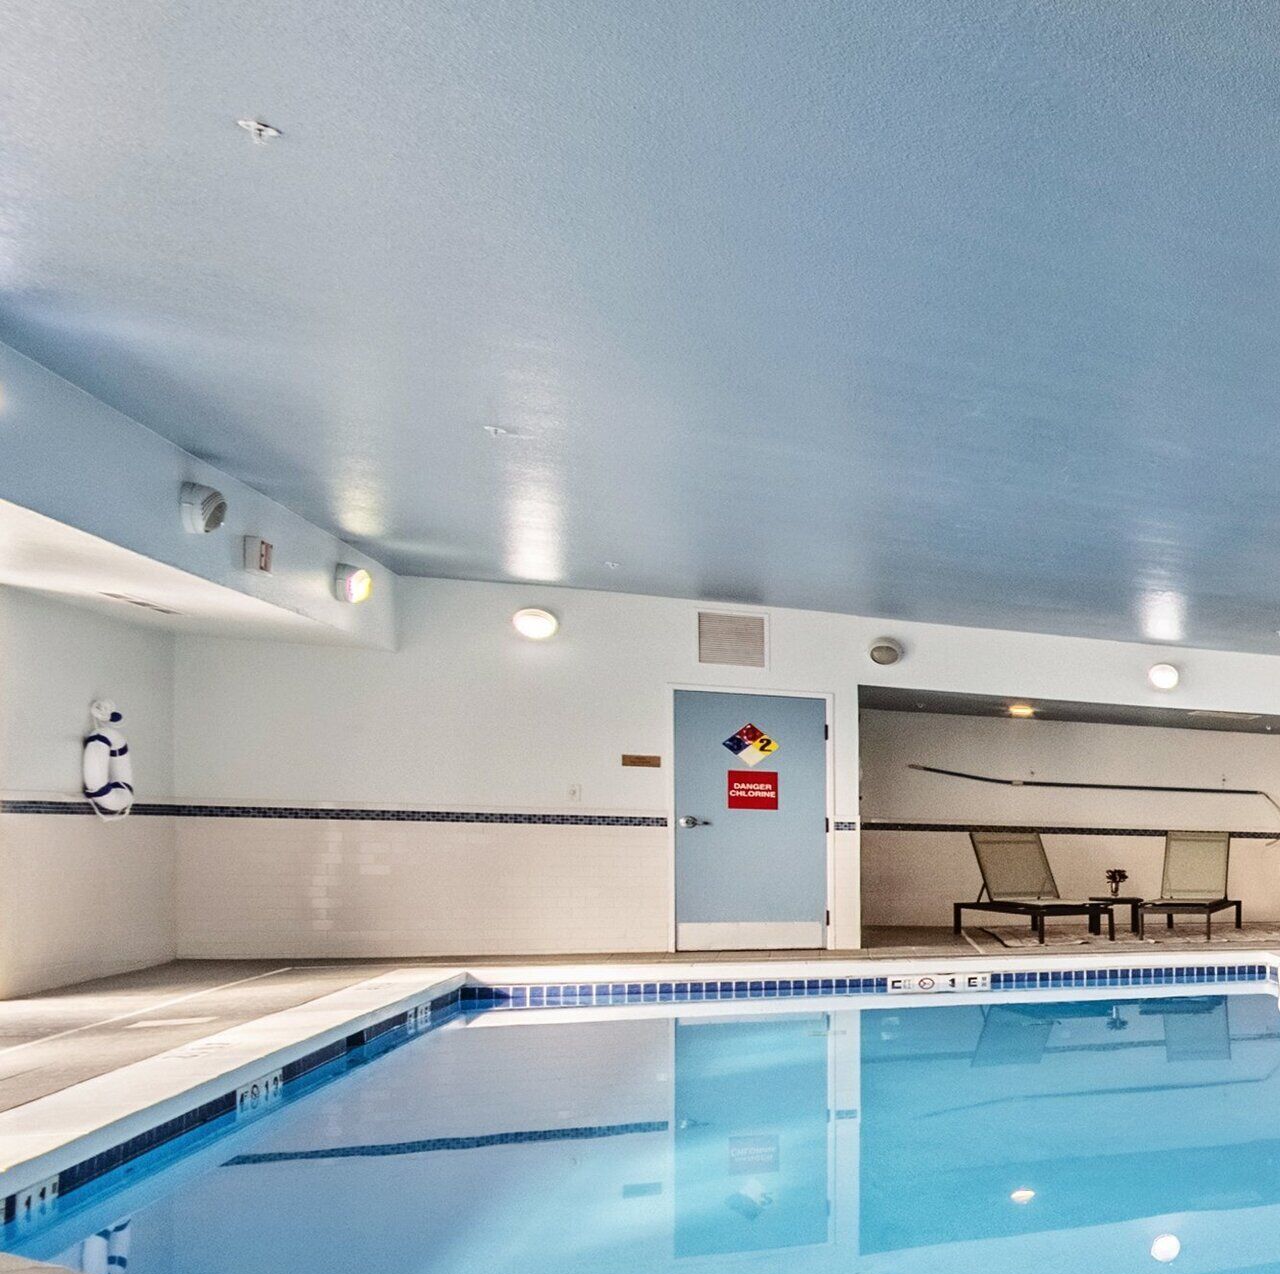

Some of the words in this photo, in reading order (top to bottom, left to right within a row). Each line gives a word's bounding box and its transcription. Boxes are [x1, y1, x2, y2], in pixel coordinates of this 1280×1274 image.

[759, 738, 773, 752] 2
[733, 782, 772, 791] DANGER
[729, 790, 776, 798] CHLORINE
